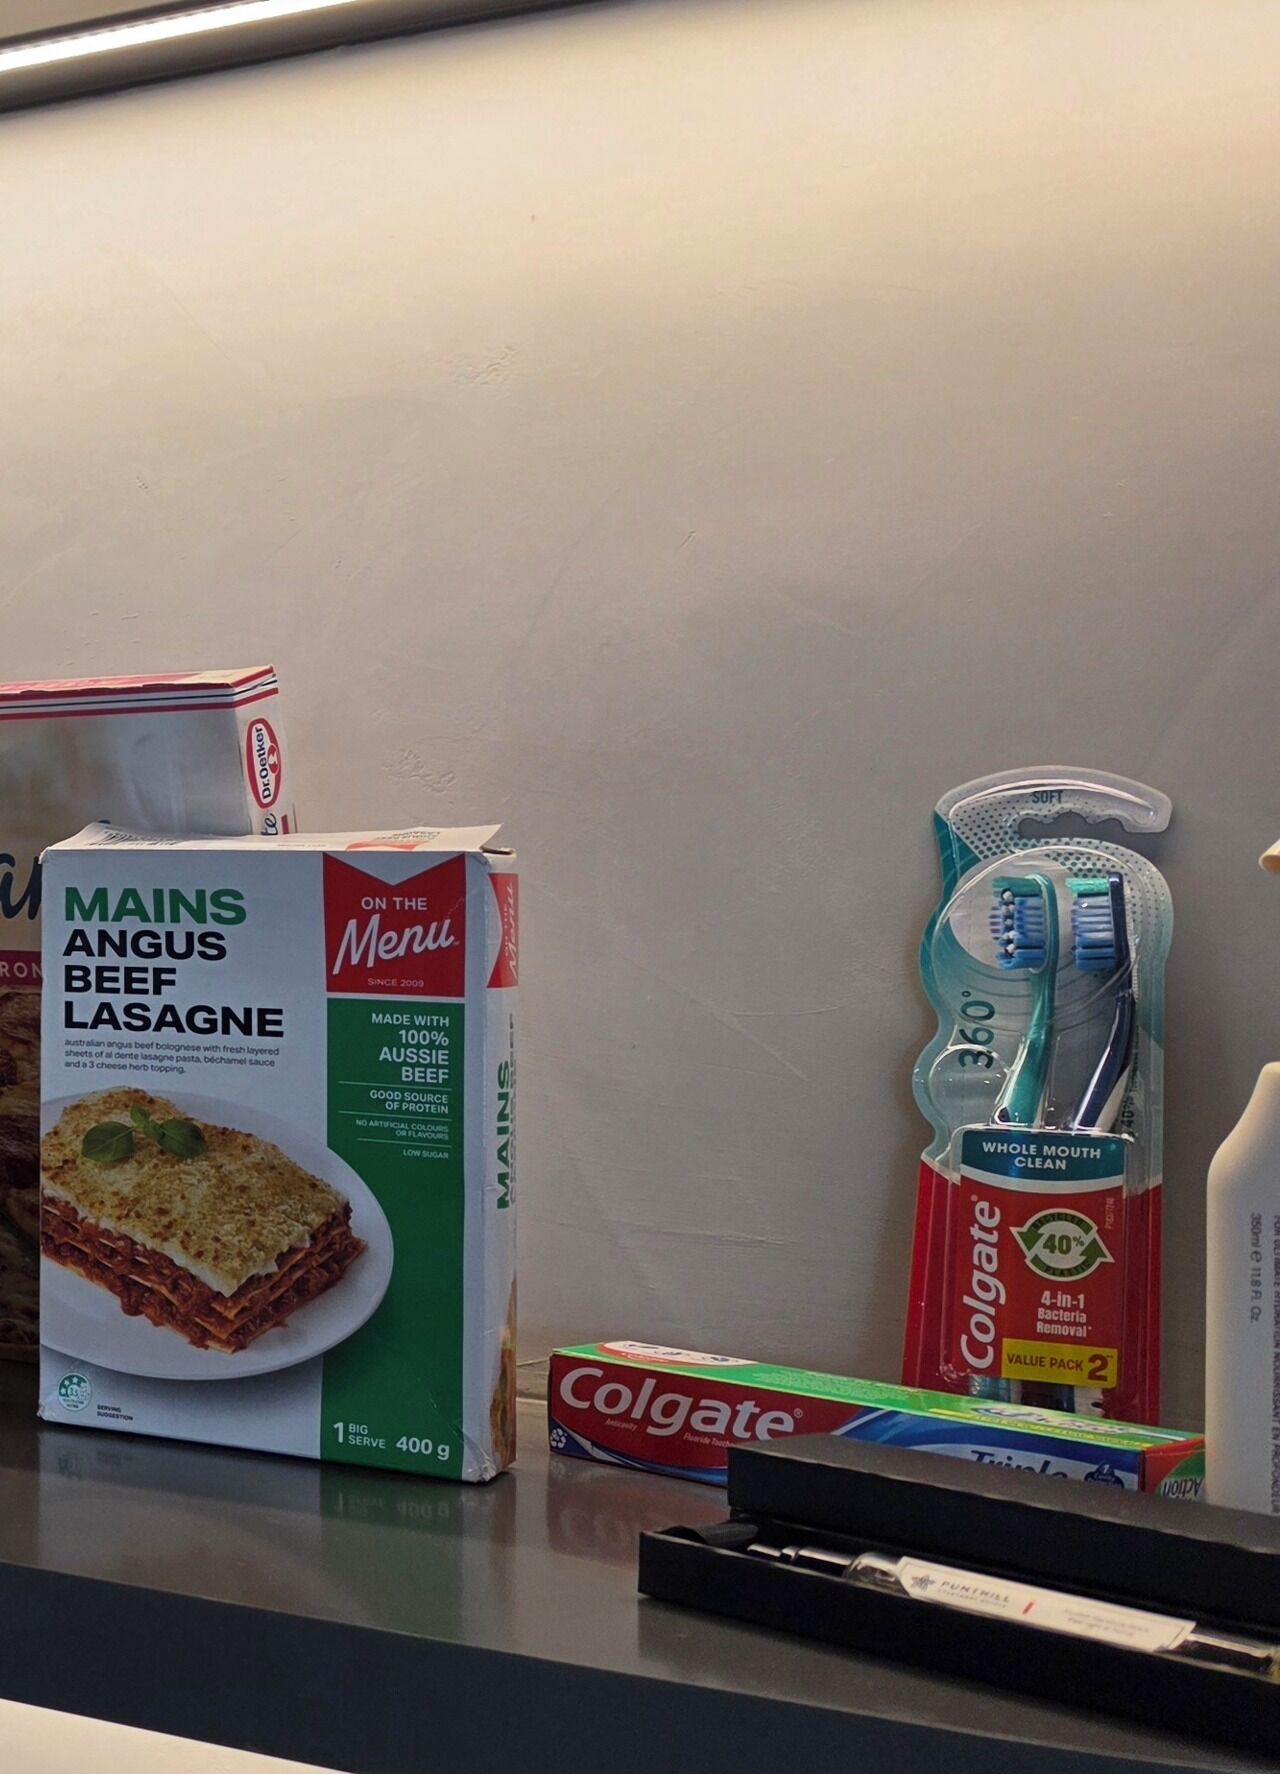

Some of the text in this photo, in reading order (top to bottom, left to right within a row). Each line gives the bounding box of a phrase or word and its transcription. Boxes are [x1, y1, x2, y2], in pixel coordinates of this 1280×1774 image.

[1032, 790, 1065, 805] SOFT
[65, 886, 247, 925] MAINS
[361, 896, 428, 911] ON THE
[62, 928, 228, 961] ANGUS
[332, 913, 456, 975] Menu
[64, 964, 177, 996] BEEF
[367, 977, 425, 988] SINCE 2009
[64, 1000, 285, 1039] LASAGNE
[371, 1012, 450, 1028] MADE WITH
[398, 1029, 450, 1047] 100%
[64, 1039, 280, 1058] australian angus beef bolognese with fresh layered
[378, 1046, 450, 1066] AUSSIE
[64, 1049, 276, 1067] sheets of al dente lasagne pasta, béchamel sauce
[401, 1066, 449, 1085] BEEF
[369, 1089, 449, 1104] GOOD SOURCE
[385, 1101, 449, 1114] OF PROTEIN
[355, 1119, 449, 1133] NO ARTIFICIAL COLOURS
[395, 1128, 449, 1141] OR FLAVOURS
[496, 1060, 510, 1210] MAINS
[403, 1149, 449, 1160] LOW SUGAR
[982, 1141, 1102, 1159] WHOLE MOUTH
[1014, 1156, 1067, 1171] CLEAN
[1042, 1233, 1086, 1256] 40%
[960, 1199, 1007, 1370] Colgate
[1040, 1291, 1086, 1309] 4-in-1
[1037, 1307, 1088, 1324] Bacteria
[1006, 1352, 1109, 1381] VALUE PACK 2
[96, 1404, 122, 1414] SERVING
[559, 1367, 795, 1441] Colgate
[96, 1411, 134, 1422] SUGGESTION
[605, 1417, 639, 1432] Anticavity
[333, 1421, 369, 1444] 1 BIG
[347, 1435, 451, 1462] SERVE 400 g
